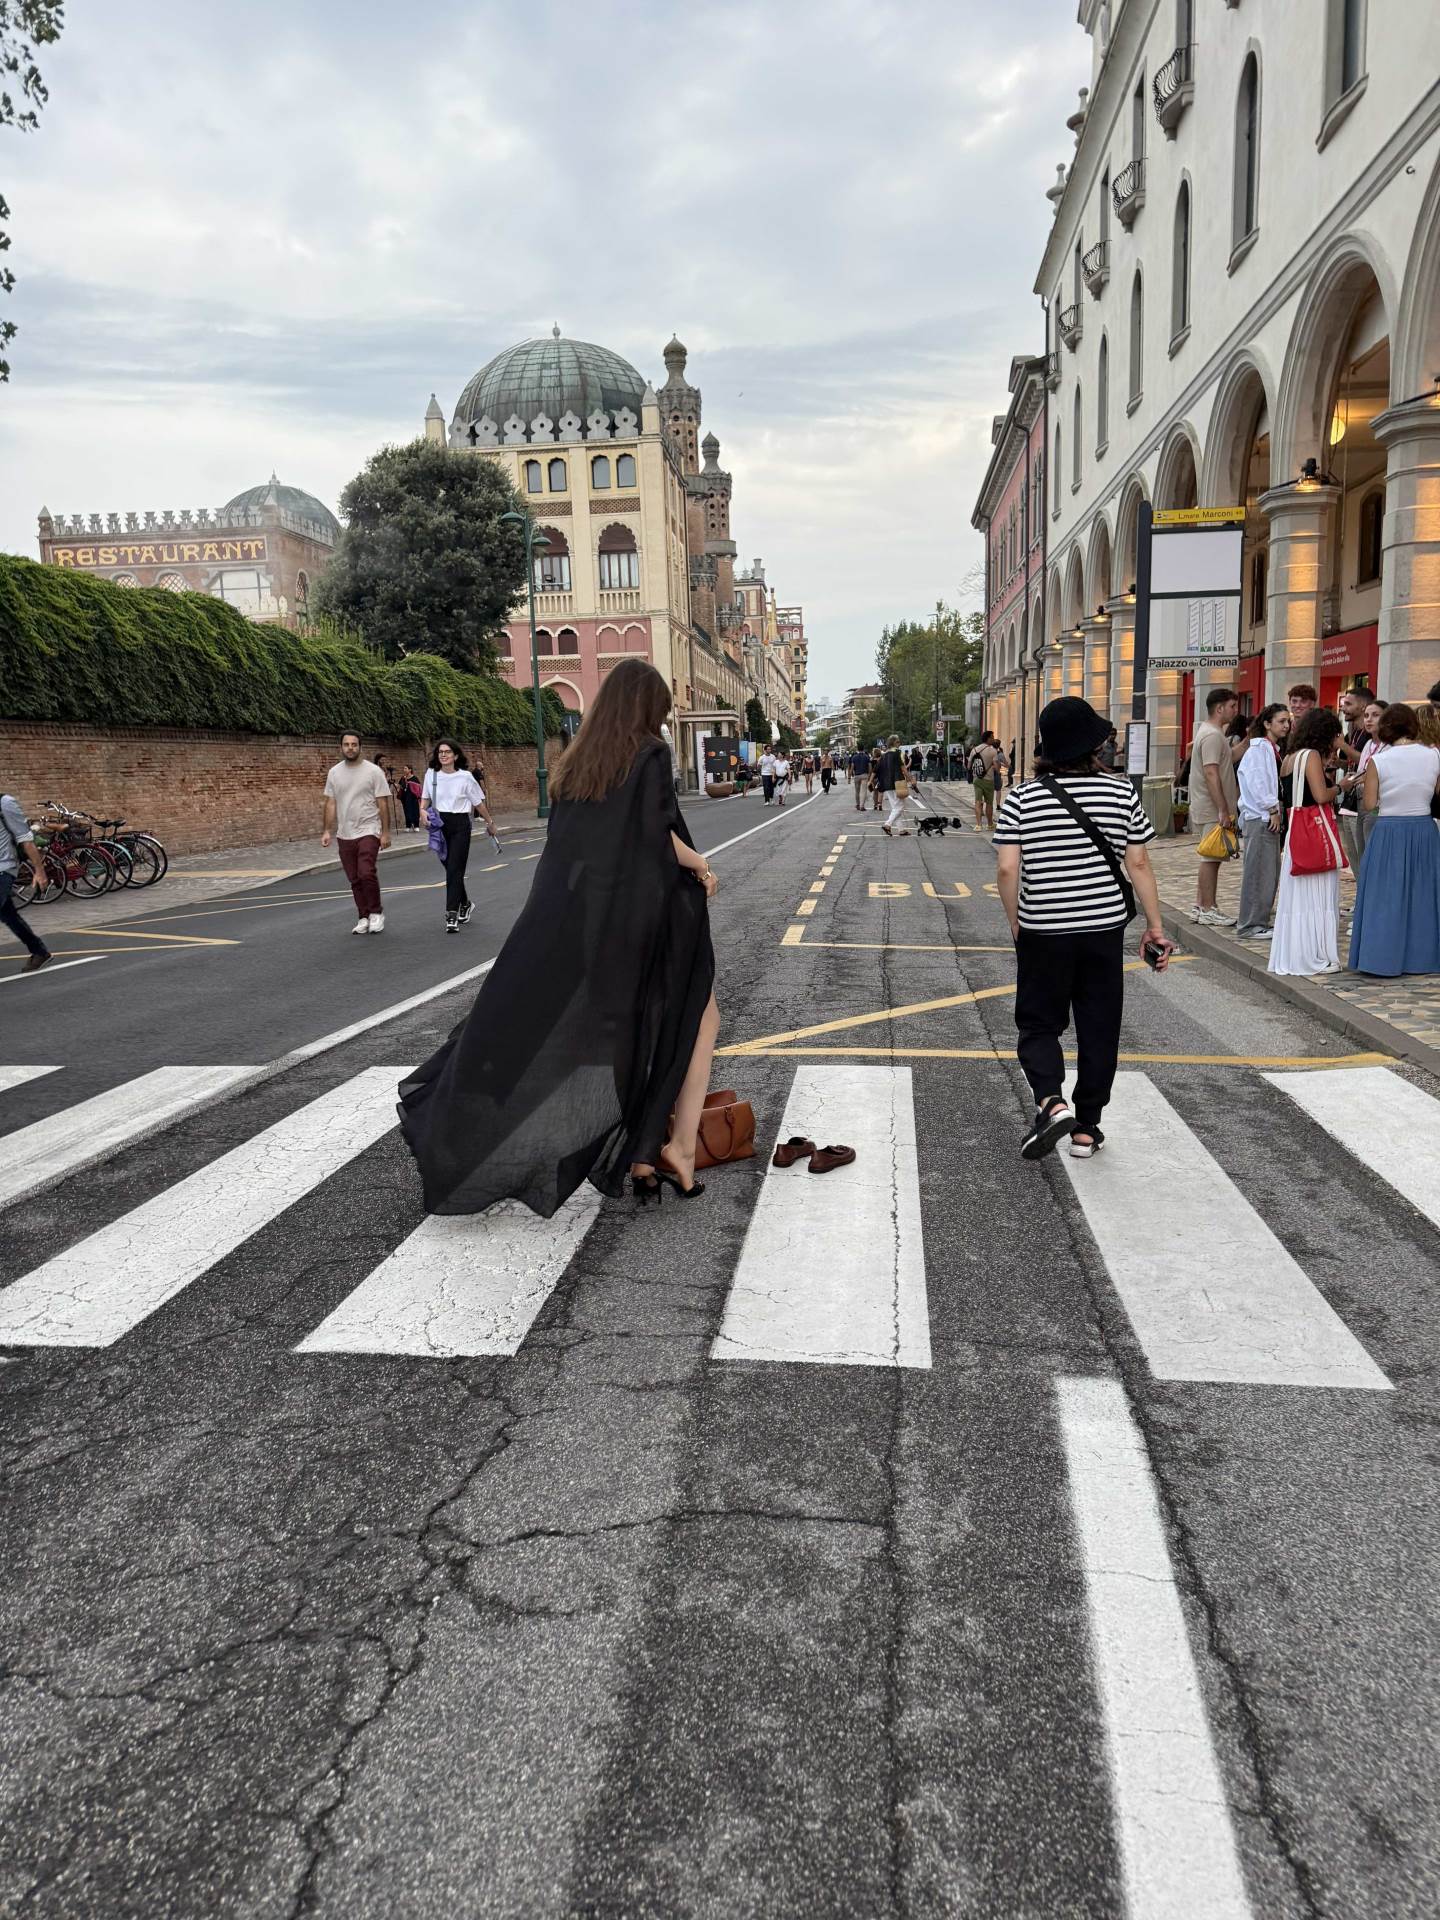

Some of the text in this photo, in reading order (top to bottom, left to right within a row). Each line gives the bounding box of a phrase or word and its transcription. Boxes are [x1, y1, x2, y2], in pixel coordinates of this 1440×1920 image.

[1202, 510, 1233, 518] Marconi
[54, 540, 264, 567] RESTAURANT
[1149, 659, 1188, 668] Palazzo
[1199, 657, 1238, 667] Cinema
